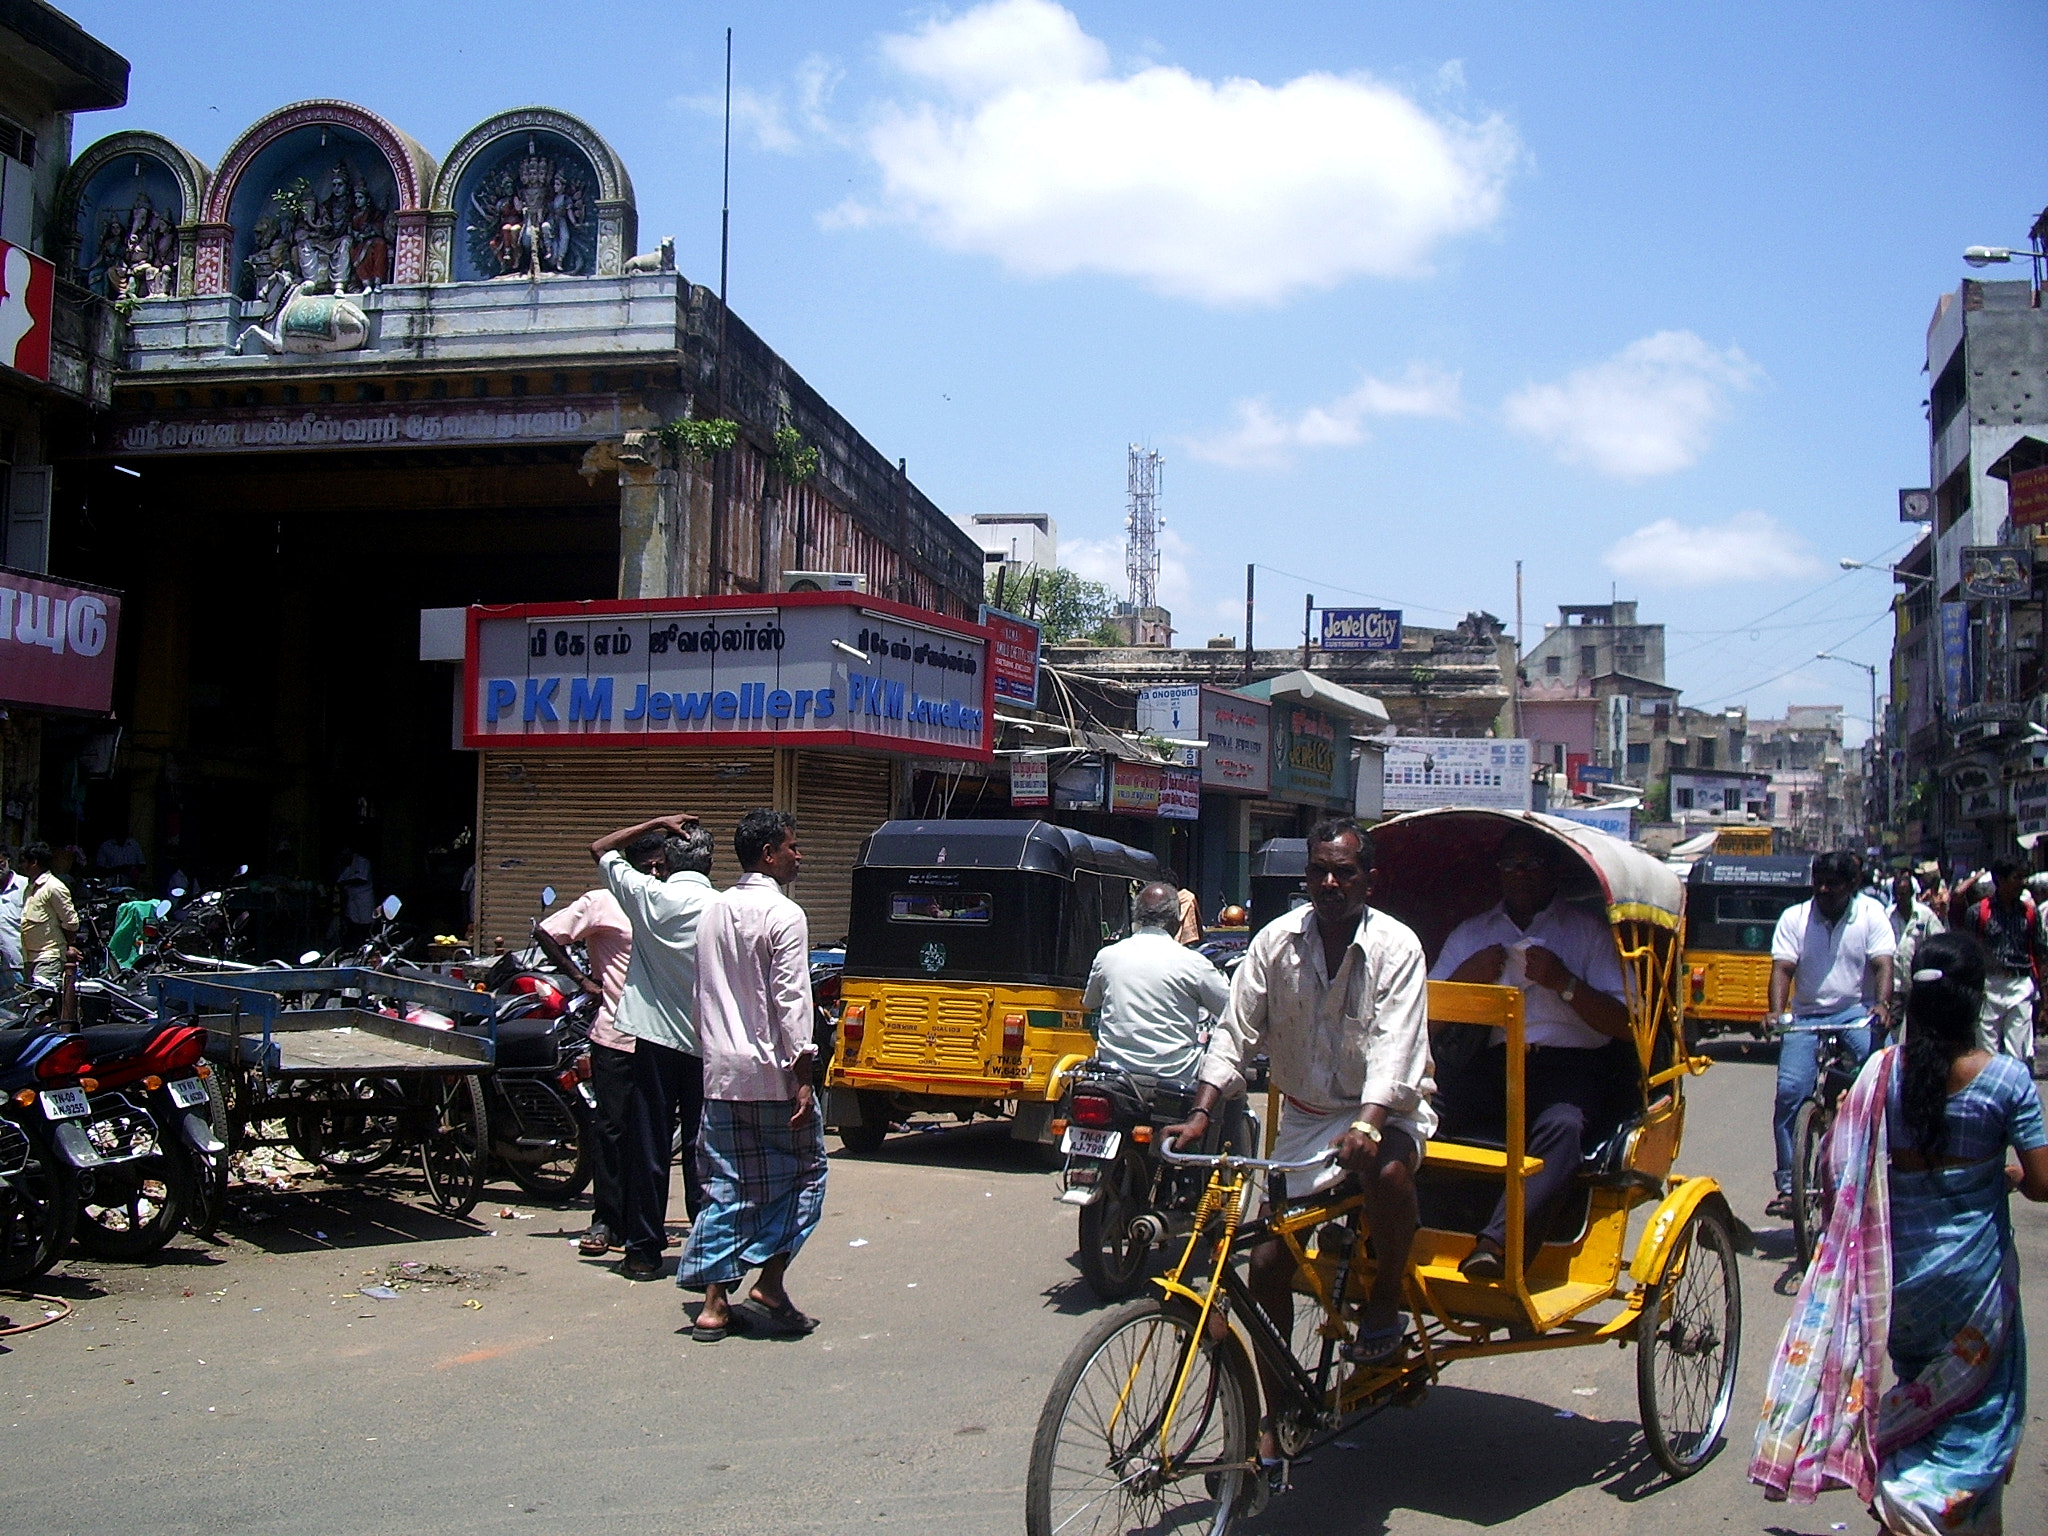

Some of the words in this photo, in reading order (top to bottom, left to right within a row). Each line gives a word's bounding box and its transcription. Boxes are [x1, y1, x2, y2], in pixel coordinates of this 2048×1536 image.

[1366, 613, 1398, 645] City
[486, 677, 614, 723] PKM
[624, 682, 836, 721] Jewellers
[848, 672, 905, 721] PKM
[907, 693, 984, 732] Jewellers
[1152, 688, 1198, 699] EUROBOND
